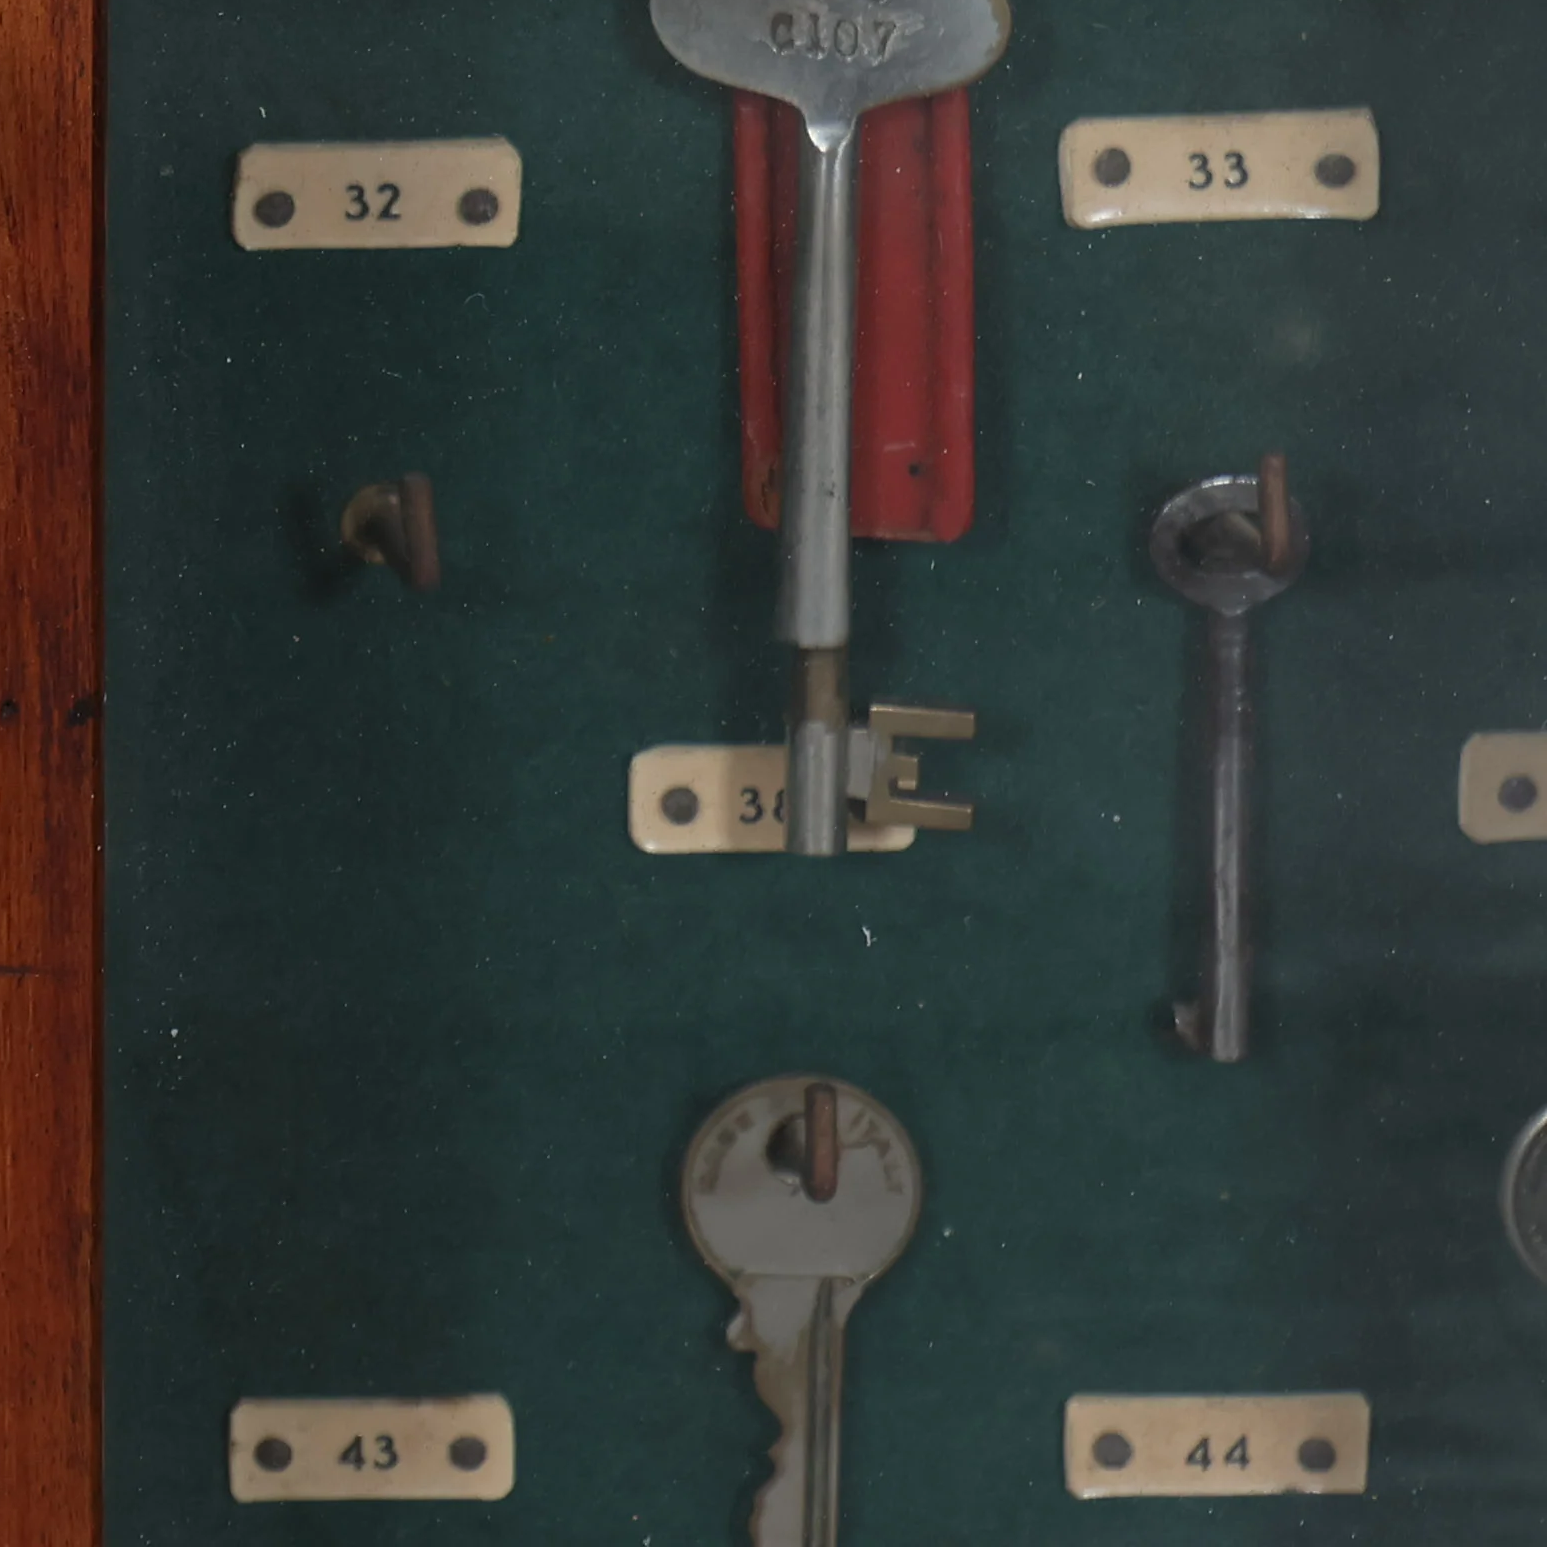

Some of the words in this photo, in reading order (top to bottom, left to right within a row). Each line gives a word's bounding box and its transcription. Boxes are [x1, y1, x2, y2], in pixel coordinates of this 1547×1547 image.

[1188, 150, 1250, 191] 33
[344, 182, 402, 222] 32
[337, 1433, 399, 1471] 43
[1185, 1433, 1251, 1472] 44
